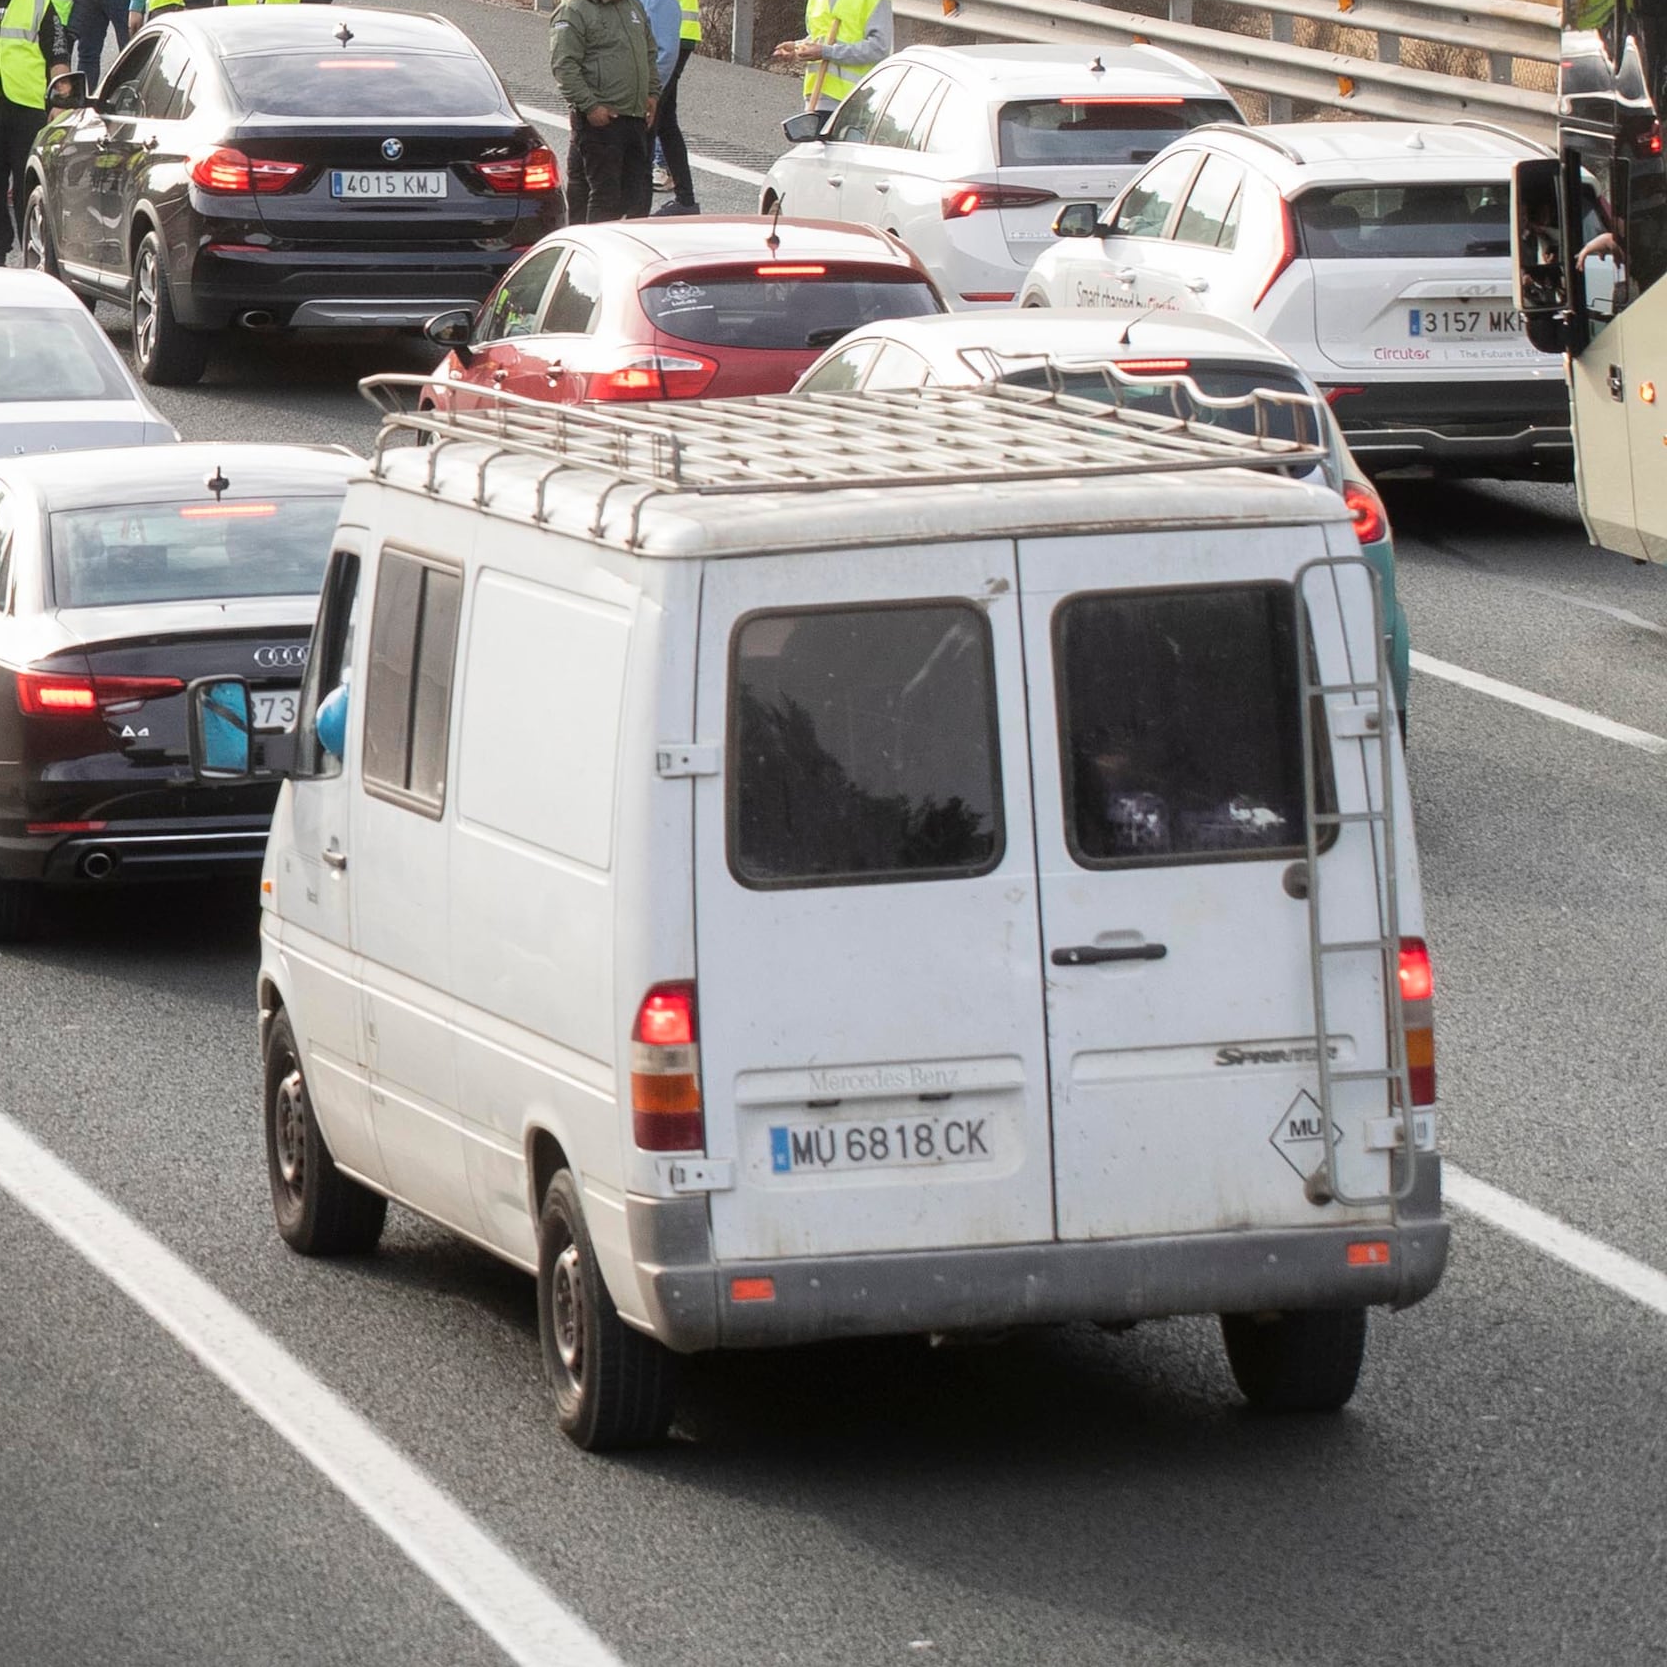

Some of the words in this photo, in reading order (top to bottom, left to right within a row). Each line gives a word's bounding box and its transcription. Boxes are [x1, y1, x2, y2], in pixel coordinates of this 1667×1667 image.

[346, 175, 397, 194] 4015
[404, 175, 441, 194] KMJ
[1425, 311, 1481, 333] 3157
[1373, 347, 1430, 361] Circutor
[1460, 349, 1479, 359] The
[1481, 349, 1512, 359] Future
[1515, 349, 1524, 359] is
[120, 724, 150, 738] A4
[789, 1127, 837, 1167] MU
[846, 1122, 935, 1162] 6818
[944, 1118, 989, 1156] CK
